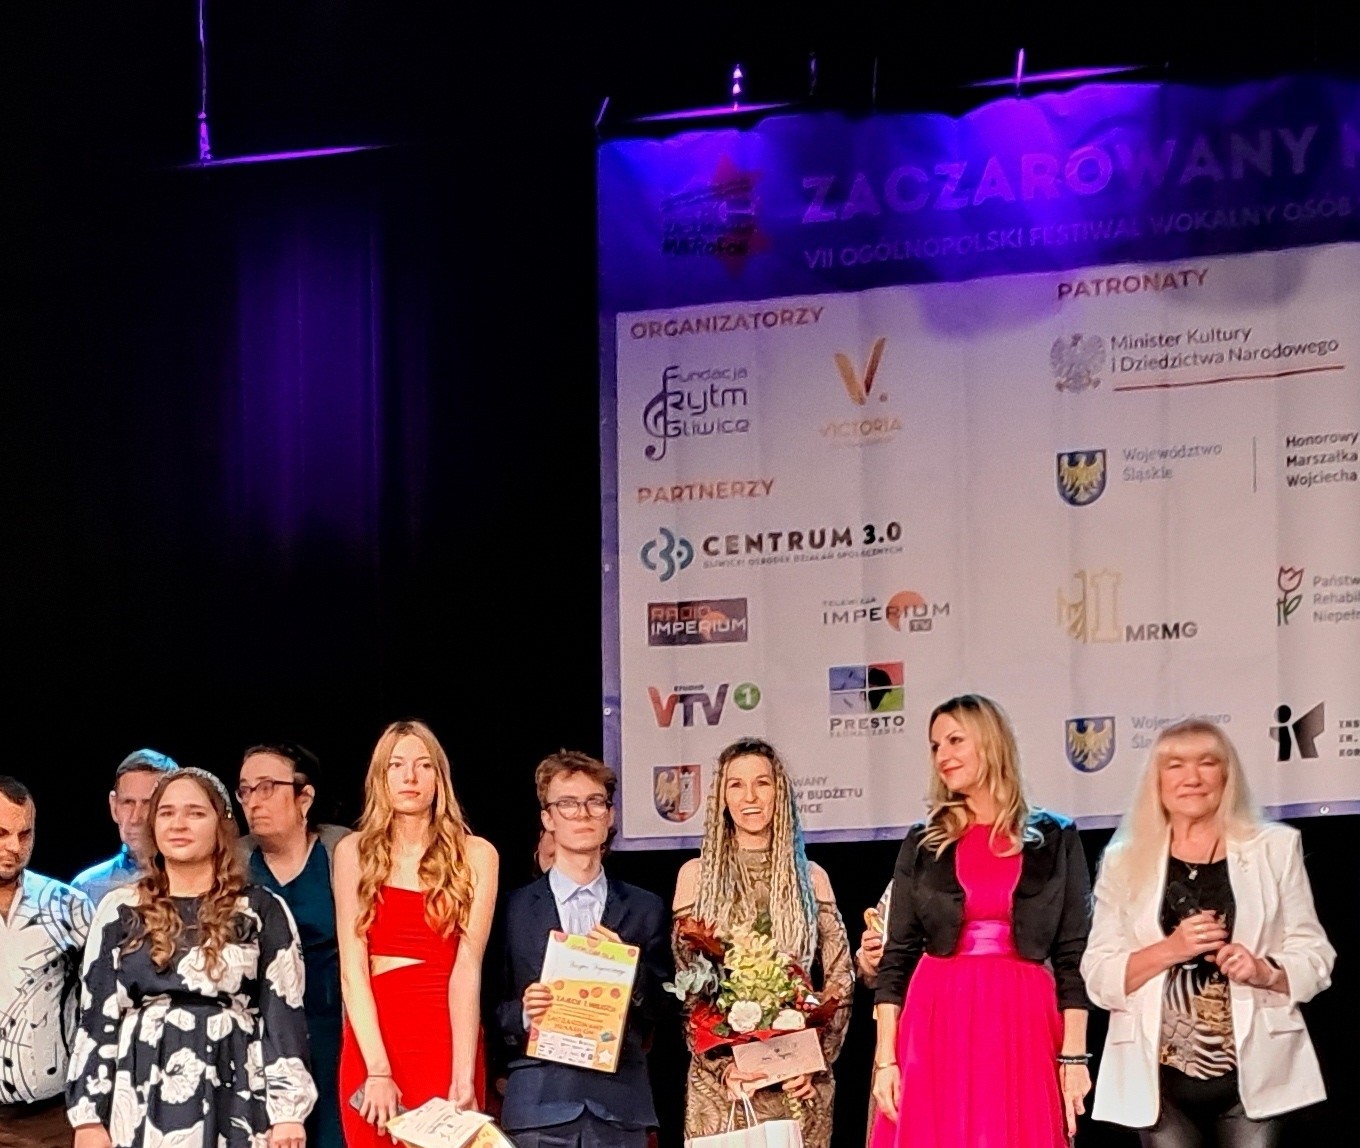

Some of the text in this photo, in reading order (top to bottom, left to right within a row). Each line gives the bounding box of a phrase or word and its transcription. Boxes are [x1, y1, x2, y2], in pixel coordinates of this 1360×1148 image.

[800, 125, 1318, 223] ZACZAROWANY
[803, 249, 833, 269] VII
[840, 223, 1025, 268] OGÓLNOPOLSKI
[1030, 219, 1140, 247] FESTIWAL
[1150, 203, 1276, 235] WOKALNY
[1283, 196, 1350, 221] OSÓB
[1057, 268, 1208, 300] PATRONATY
[630, 306, 826, 340] ORGANIZATORZY
[1111, 327, 1252, 351] Minister Kultury
[1121, 350, 1224, 373] Dziedzictwa
[1229, 338, 1340, 362] Narodowego
[663, 365, 749, 382] Fundacja
[665, 384, 748, 416] Rytm
[665, 418, 750, 438] Gliwice
[820, 417, 903, 438] VICTORIA
[1286, 430, 1359, 449] Honorowy
[1122, 442, 1223, 464] Województwo
[1286, 449, 1358, 468] Marszałka
[1122, 464, 1173, 483] Śląskie
[1286, 469, 1358, 488] Wojciecha
[638, 478, 775, 503] PARTNERZY
[703, 521, 902, 556] CENTRUM 3.0
[650, 606, 711, 620] RADIO
[823, 602, 950, 625] IMPERIUM
[651, 616, 747, 637] IMPERIUM
[1125, 621, 1198, 643] MRMG
[647, 683, 730, 728] VTV
[830, 715, 906, 731] PRESTO
[807, 786, 863, 800] BUDŻETU
